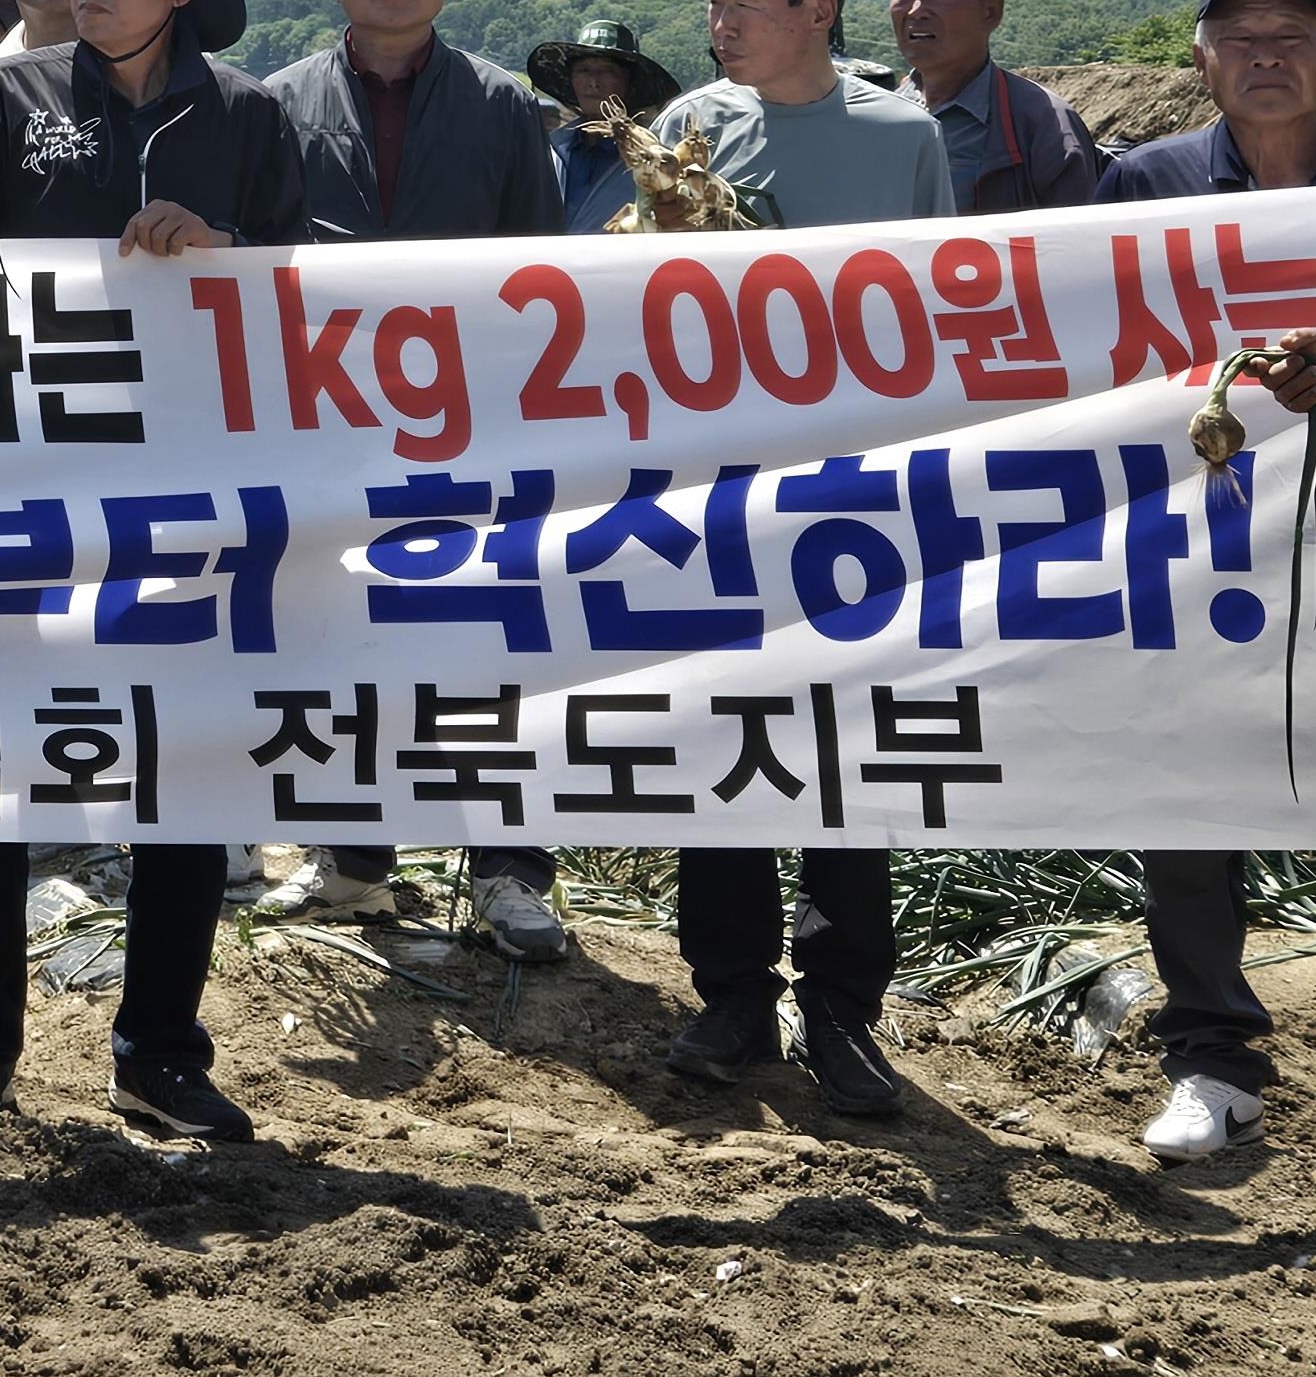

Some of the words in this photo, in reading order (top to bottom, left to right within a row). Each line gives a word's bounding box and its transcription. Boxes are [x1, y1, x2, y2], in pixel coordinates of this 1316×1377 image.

[189, 266, 472, 463] 1kg
[497, 236, 1070, 442] 2,000원
[364, 443, 1267, 654] 혁신하라!
[248, 682, 1003, 830] 전북도지부
